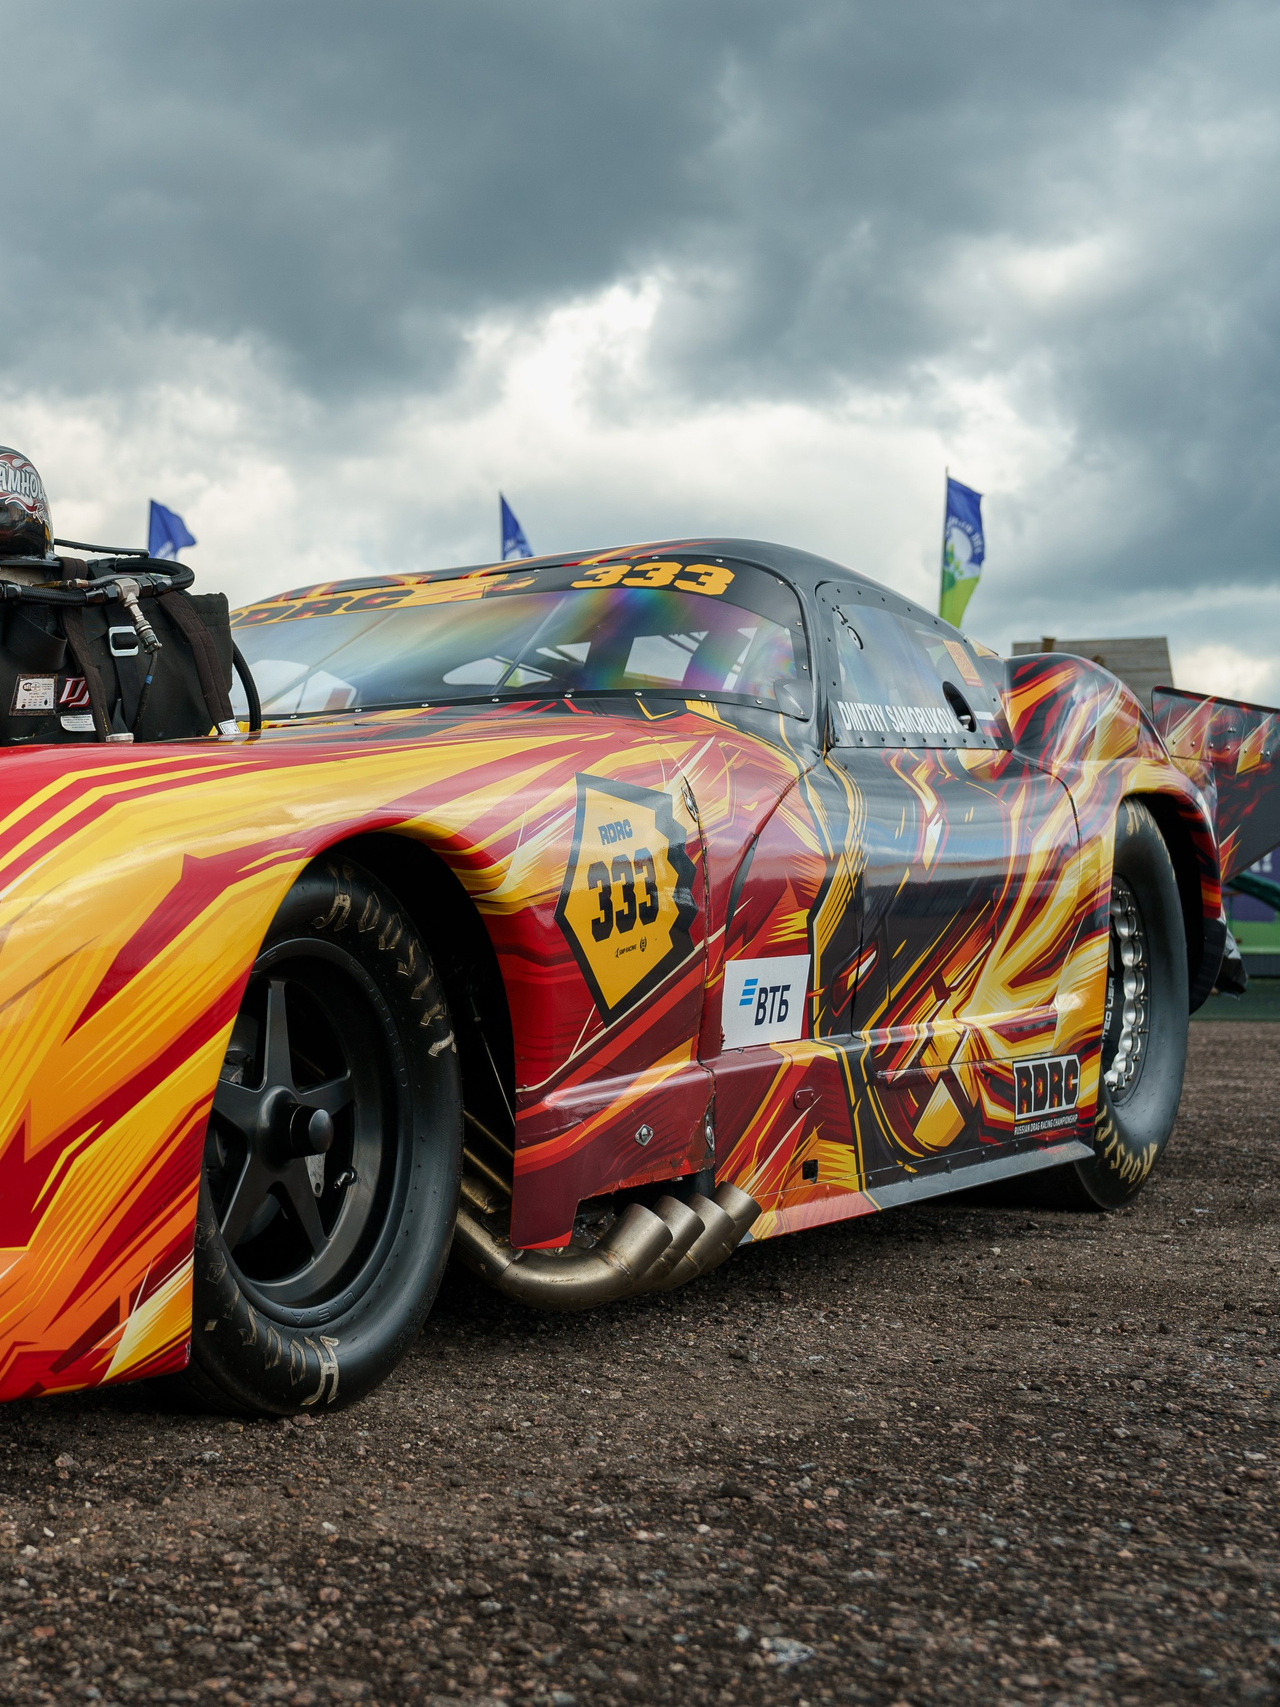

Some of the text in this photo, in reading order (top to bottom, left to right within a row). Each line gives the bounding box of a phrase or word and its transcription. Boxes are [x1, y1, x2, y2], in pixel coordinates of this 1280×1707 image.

[571, 561, 735, 595] 333
[837, 701, 959, 734] DMITRIY SAMORUKOV
[587, 848, 661, 943] 333
[754, 984, 792, 1026] ВТБ
[1014, 1057, 1079, 1116] RDRC
[1014, 1113, 1078, 1136] RUSSIAN DRAG RACING CHAMPIONSHIP
